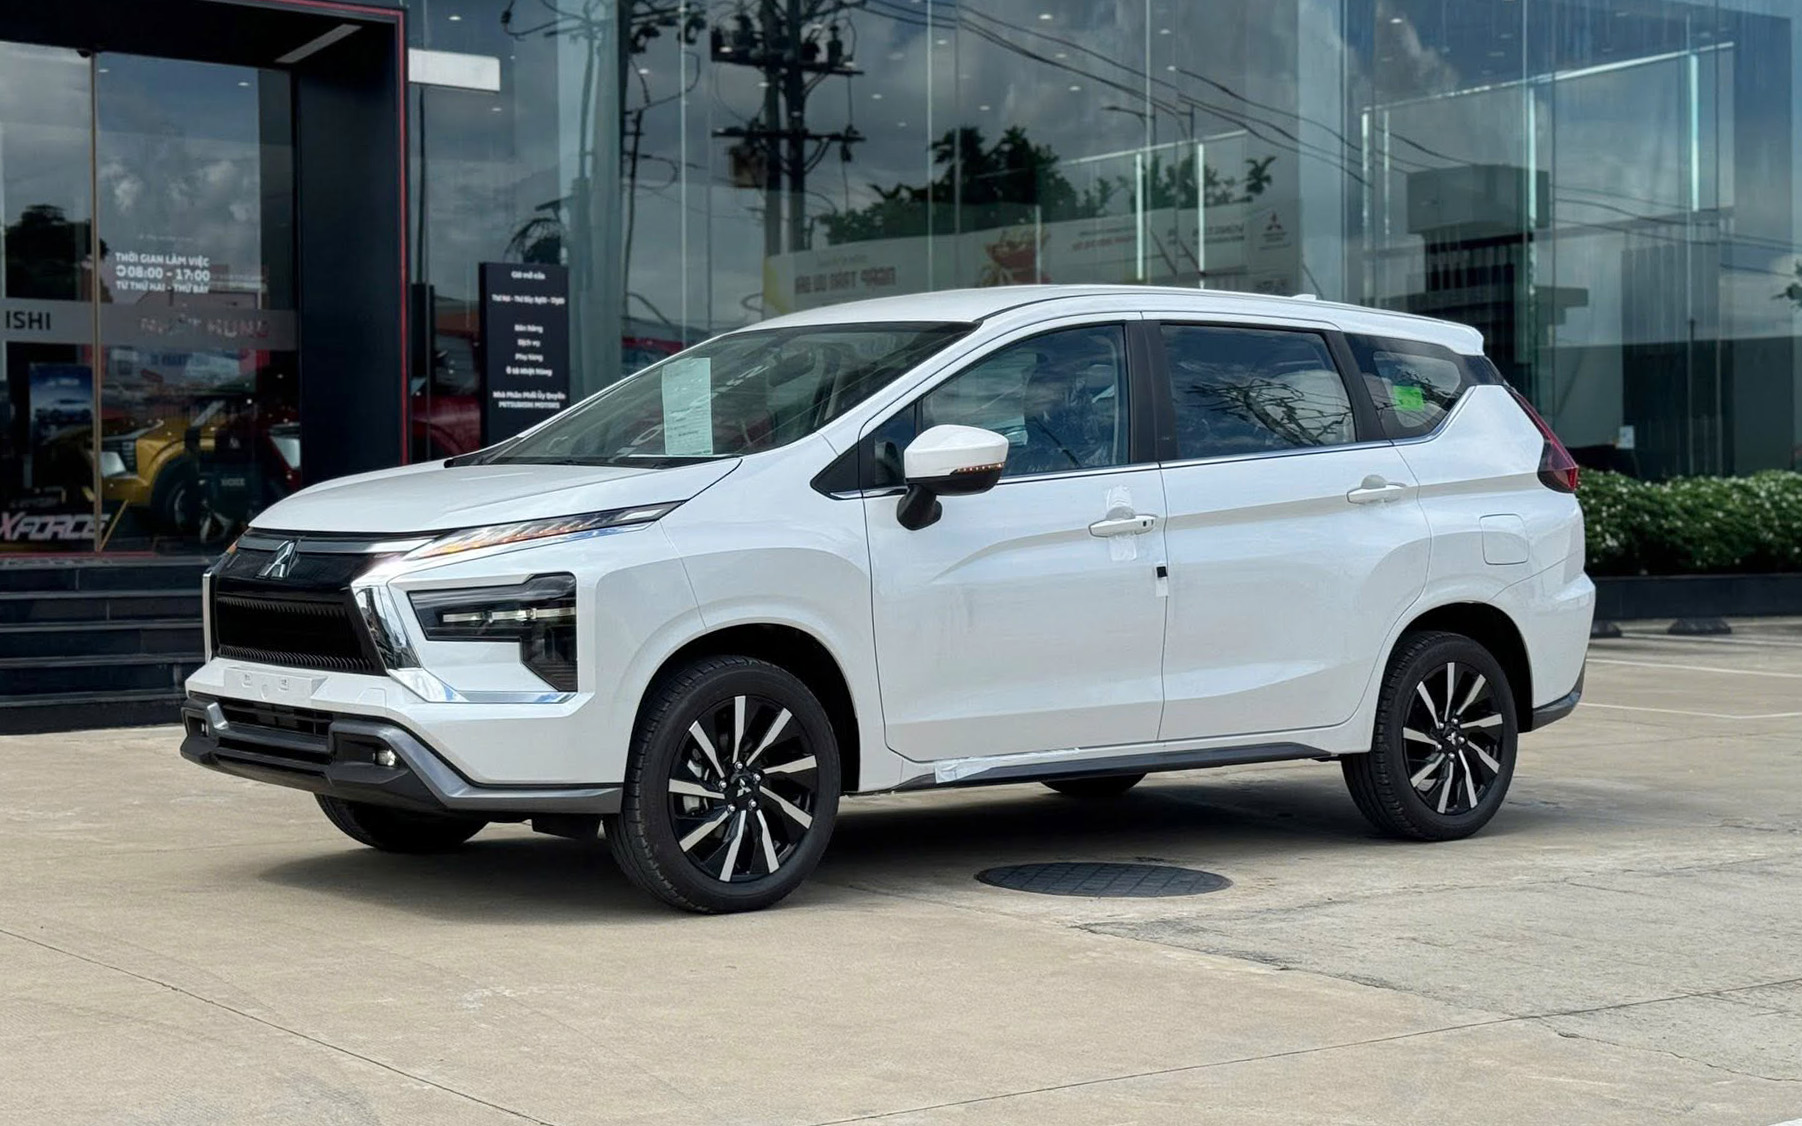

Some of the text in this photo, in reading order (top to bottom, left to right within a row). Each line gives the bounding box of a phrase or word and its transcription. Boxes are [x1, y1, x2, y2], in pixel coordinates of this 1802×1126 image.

[115, 252, 210, 268] THỜI GIAN LÀM VIỆC
[127, 266, 163, 279] 08:00
[176, 268, 210, 281] 17:00
[149, 282, 165, 292] HAI
[6, 310, 51, 330] ISHI
[0, 511, 112, 541] XFORCE
